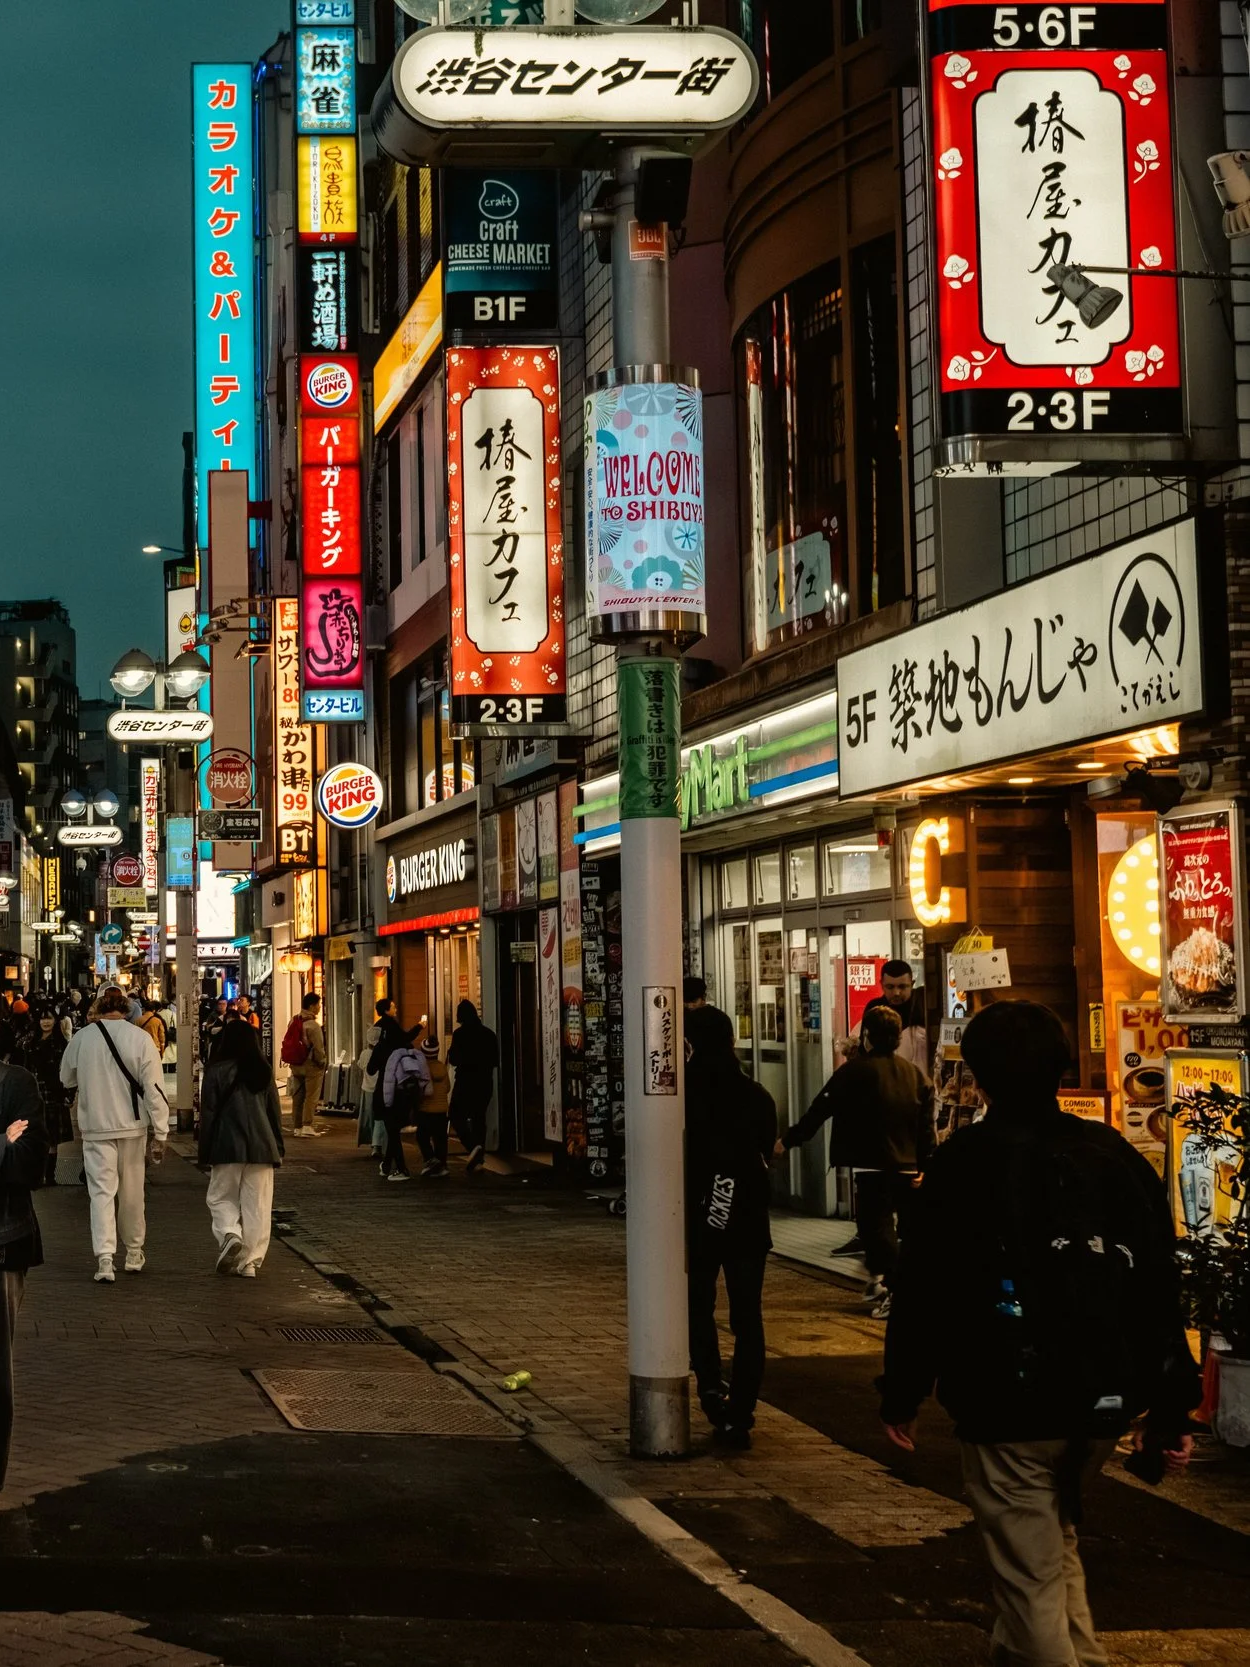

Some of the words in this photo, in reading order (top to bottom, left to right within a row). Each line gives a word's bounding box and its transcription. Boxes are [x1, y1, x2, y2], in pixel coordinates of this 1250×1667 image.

[298, 2, 352, 19] センタービル
[310, 43, 341, 116] 麻雀
[415, 56, 737, 97] 渋谷センター街
[323, 146, 345, 225] 鳥貴族
[319, 233, 336, 242] 4F
[479, 219, 519, 242] Craft
[448, 244, 490, 260] CHEESE
[493, 242, 551, 265] MARKET
[310, 250, 338, 351] 一軒め酒場
[473, 296, 527, 322] B1F
[312, 371, 347, 389] BURGER
[314, 379, 348, 397] KING
[603, 449, 703, 499] WELCOME
[318, 425, 343, 568] バーガーキング
[473, 417, 533, 623] 椿屋カフェ
[601, 506, 624, 523] TO
[625, 499, 705, 526] SHIBUYA
[602, 596, 653, 607] SHIBUYA
[888, 613, 1098, 755] 築地もんじゃ
[306, 697, 362, 715] センタービル
[846, 689, 877, 749] 5F
[114, 719, 209, 732] 渋谷センター街
[643, 668, 669, 809] 落書きは犯罪です
[281, 731, 307, 791] かわ串
[209, 771, 248, 790] 消火栓
[325, 775, 374, 800] BURGER
[145, 775, 158, 819] カラオケ
[282, 793, 308, 810] 99
[327, 786, 377, 817] KING
[280, 829, 310, 854] B1
[400, 851, 438, 896] BURGER
[438, 837, 466, 886] KING
[849, 964, 872, 976] 銀行
[850, 977, 872, 985] ATM
[261, 1009, 273, 1038] BOSS
[1063, 1099, 1097, 1109] COMBOS
